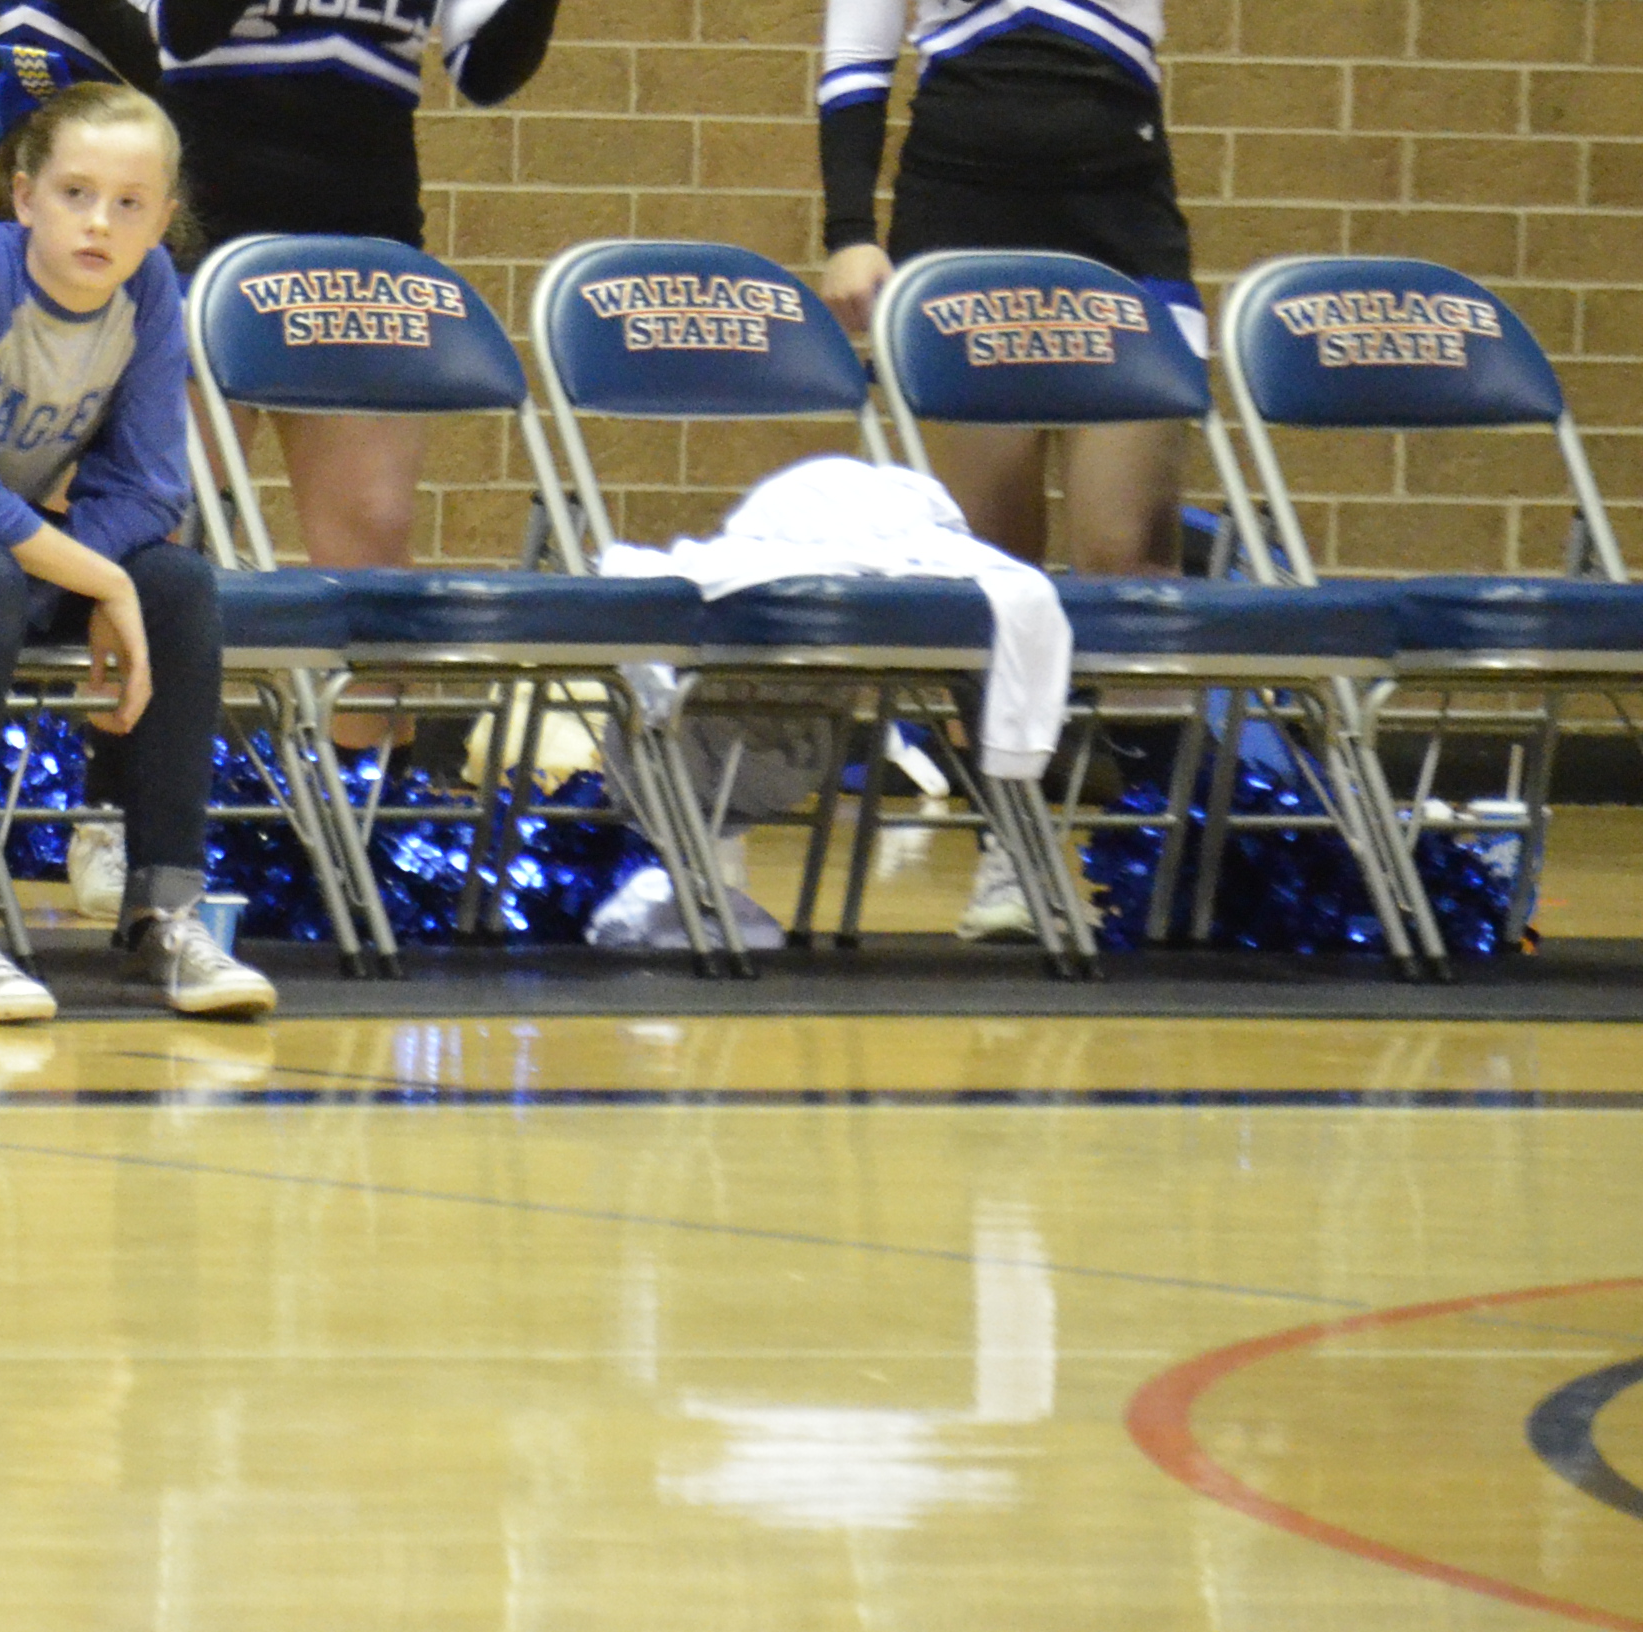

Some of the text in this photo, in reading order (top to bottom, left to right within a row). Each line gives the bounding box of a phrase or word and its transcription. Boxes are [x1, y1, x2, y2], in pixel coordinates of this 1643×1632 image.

[239, 268, 468, 318] WALLACE
[581, 273, 806, 323] WALLACE
[921, 286, 1150, 335] WALLACE
[1272, 289, 1503, 339] WALLACE
[283, 306, 431, 348] STATE
[625, 311, 770, 353] STATE
[966, 325, 1116, 367] STATE
[1317, 329, 1468, 368] STATE
